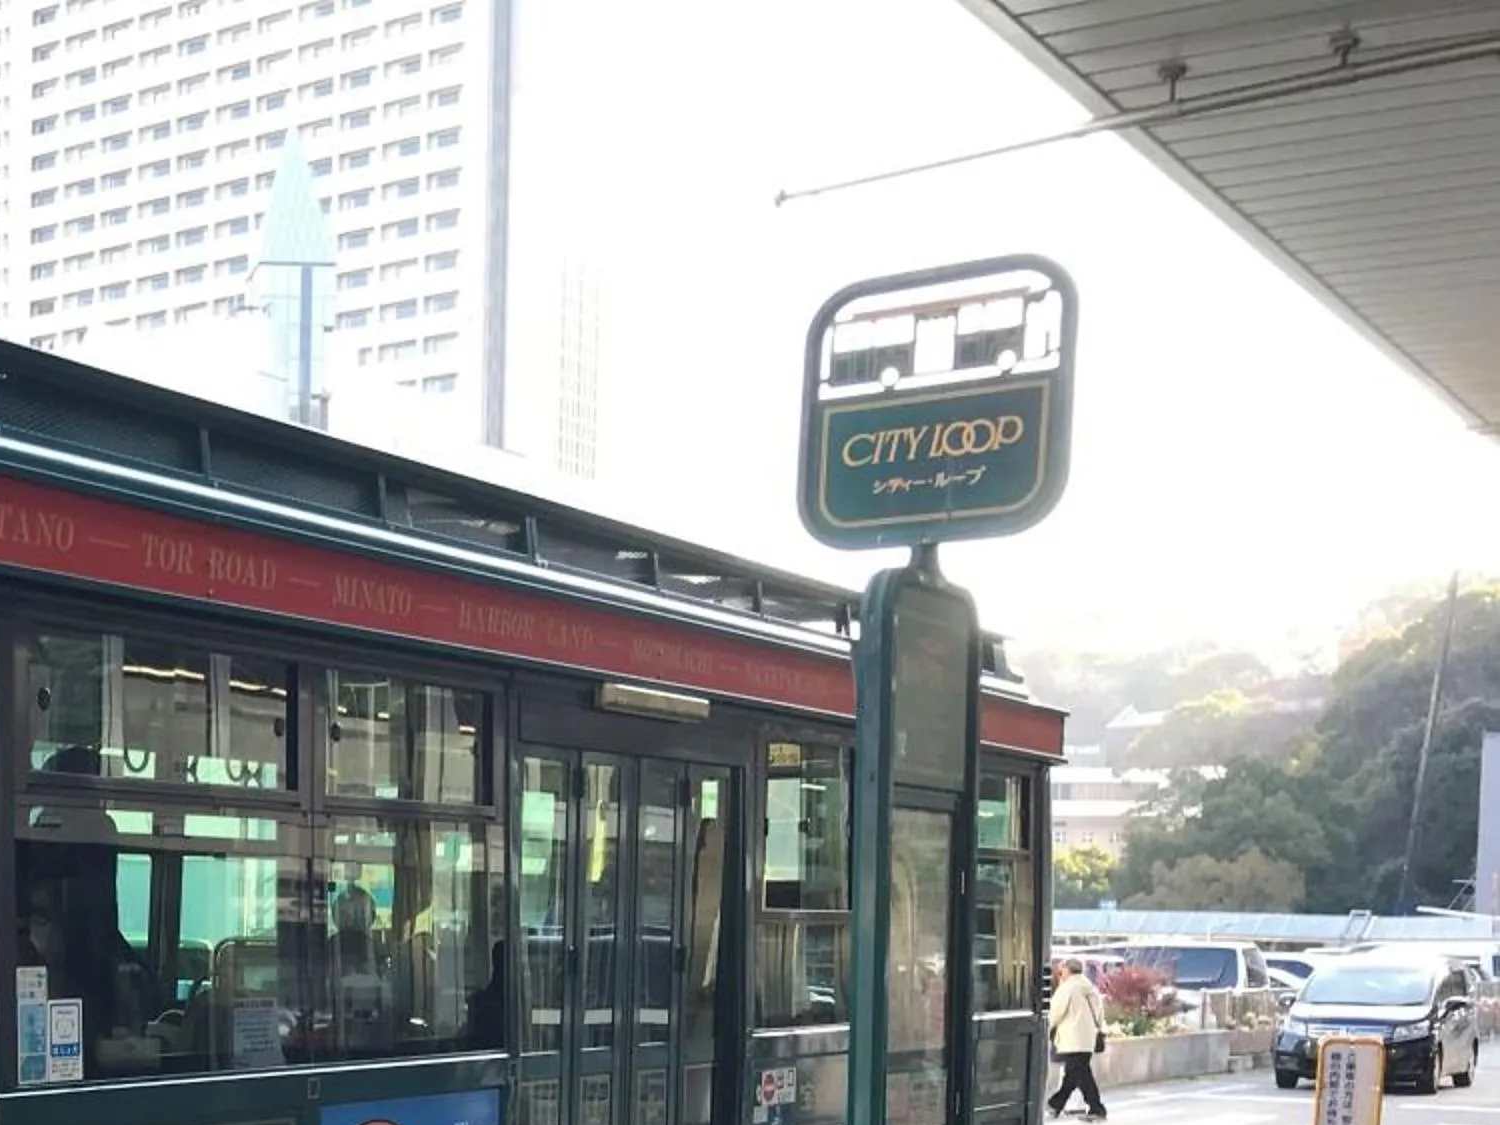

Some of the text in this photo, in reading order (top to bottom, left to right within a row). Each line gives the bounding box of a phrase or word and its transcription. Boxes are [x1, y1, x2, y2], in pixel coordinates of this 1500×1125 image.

[841, 414, 1024, 467] CITY LOOP
[141, 532, 194, 577] TOR
[208, 541, 278, 592] ROAD
[331, 572, 413, 618] MINATO
